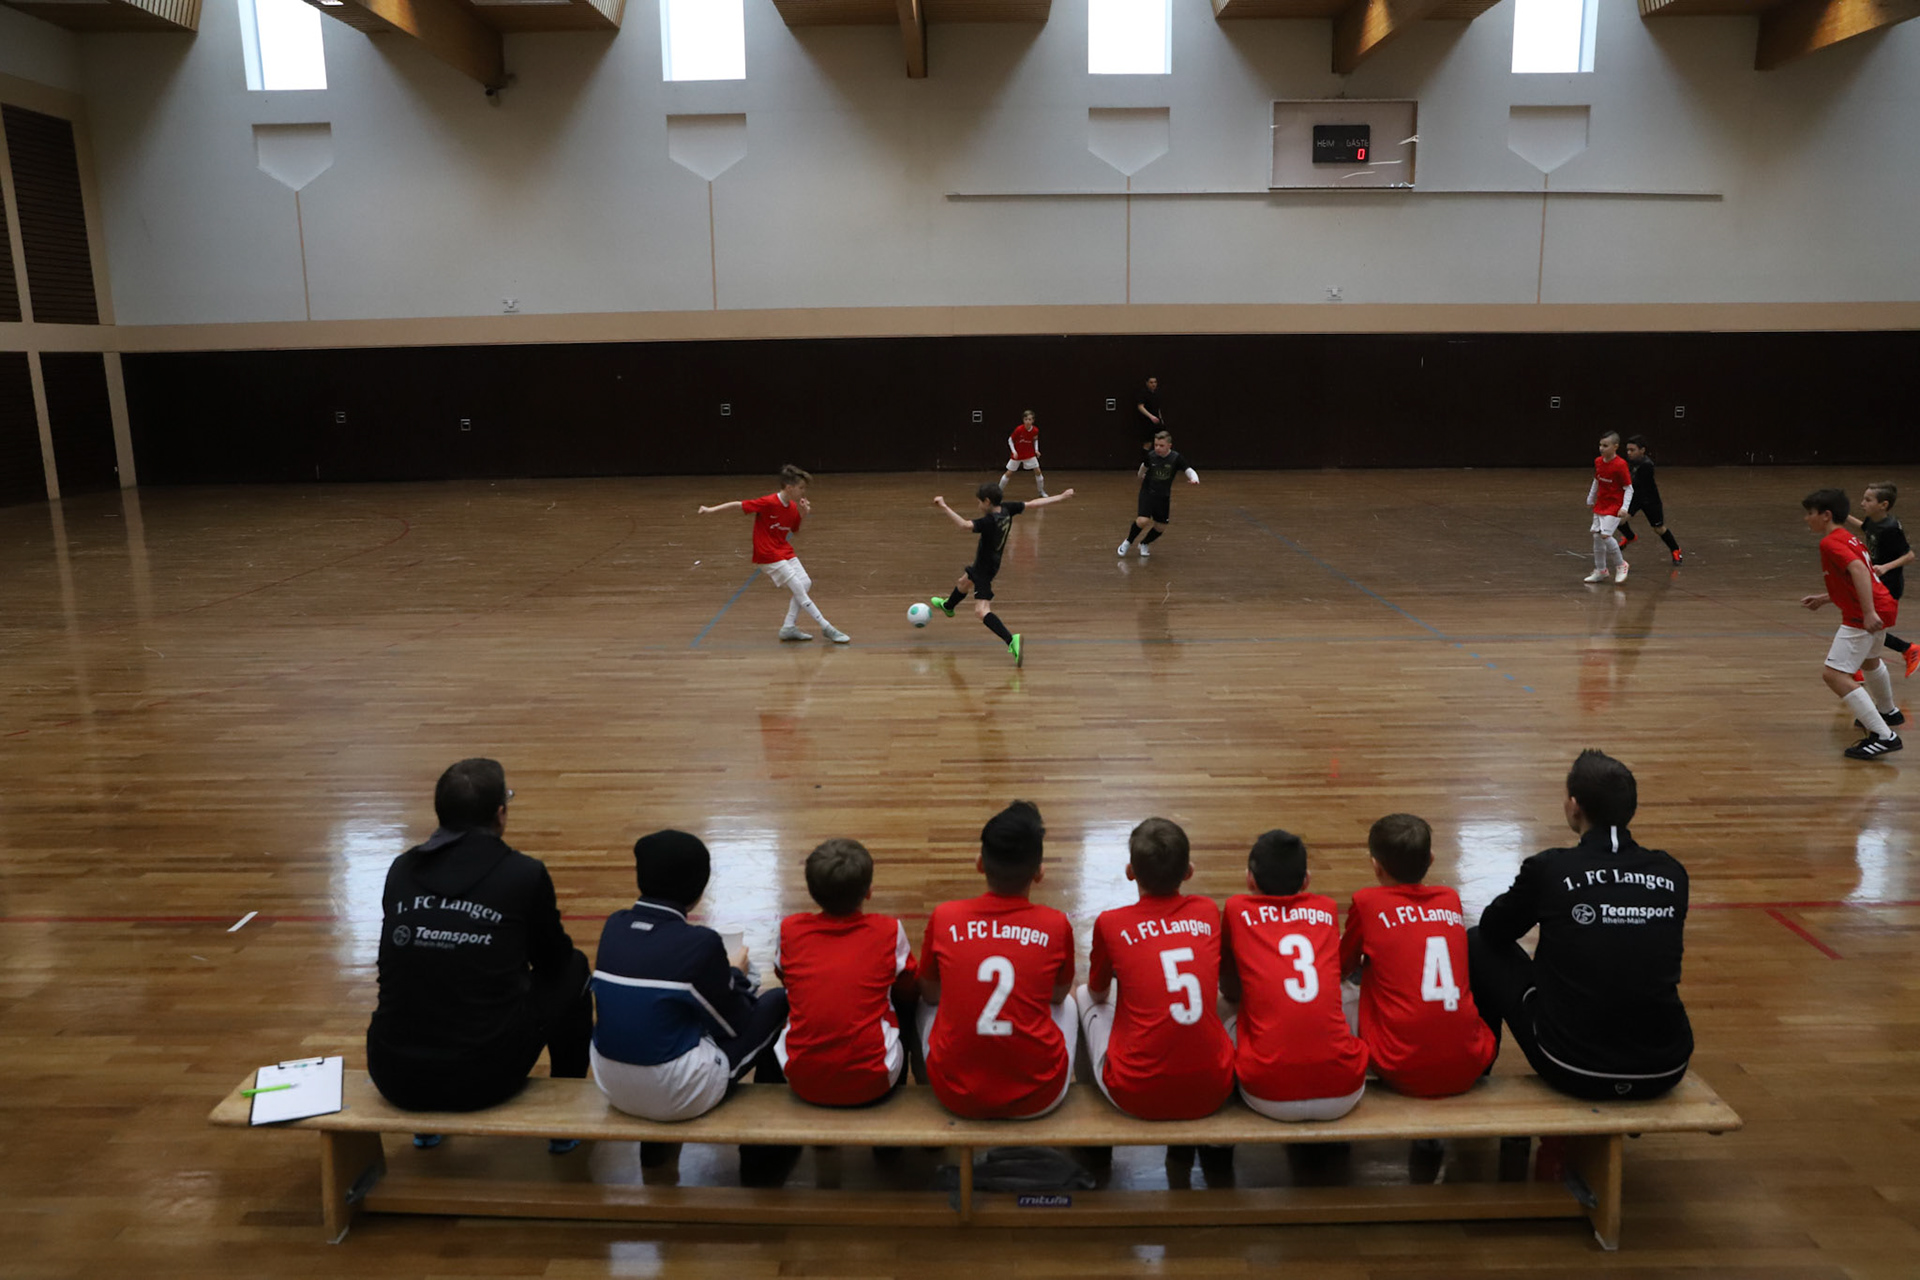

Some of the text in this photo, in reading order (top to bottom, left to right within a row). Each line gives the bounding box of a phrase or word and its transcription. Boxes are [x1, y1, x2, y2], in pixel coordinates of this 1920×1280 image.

[1357, 148, 1366, 160] 0
[1563, 868, 1675, 892] 1. FC Langen
[397, 895, 503, 924] 1. FC Langen
[1240, 905, 1333, 926] 1. FC Langen
[1378, 911, 1396, 928] 1.
[1395, 905, 1417, 924] FC
[1600, 904, 1675, 919] Teamsport
[1602, 916, 1646, 924] Rhein-Main
[415, 926, 493, 946] Teamsport
[949, 920, 1049, 947] 1. FC Langen
[1120, 919, 1212, 945] 1. FC Langen
[1278, 933, 1319, 1003] 3
[1421, 935, 1461, 1012] 4
[976, 954, 1015, 1036] 2
[1159, 946, 1203, 1025] 5
